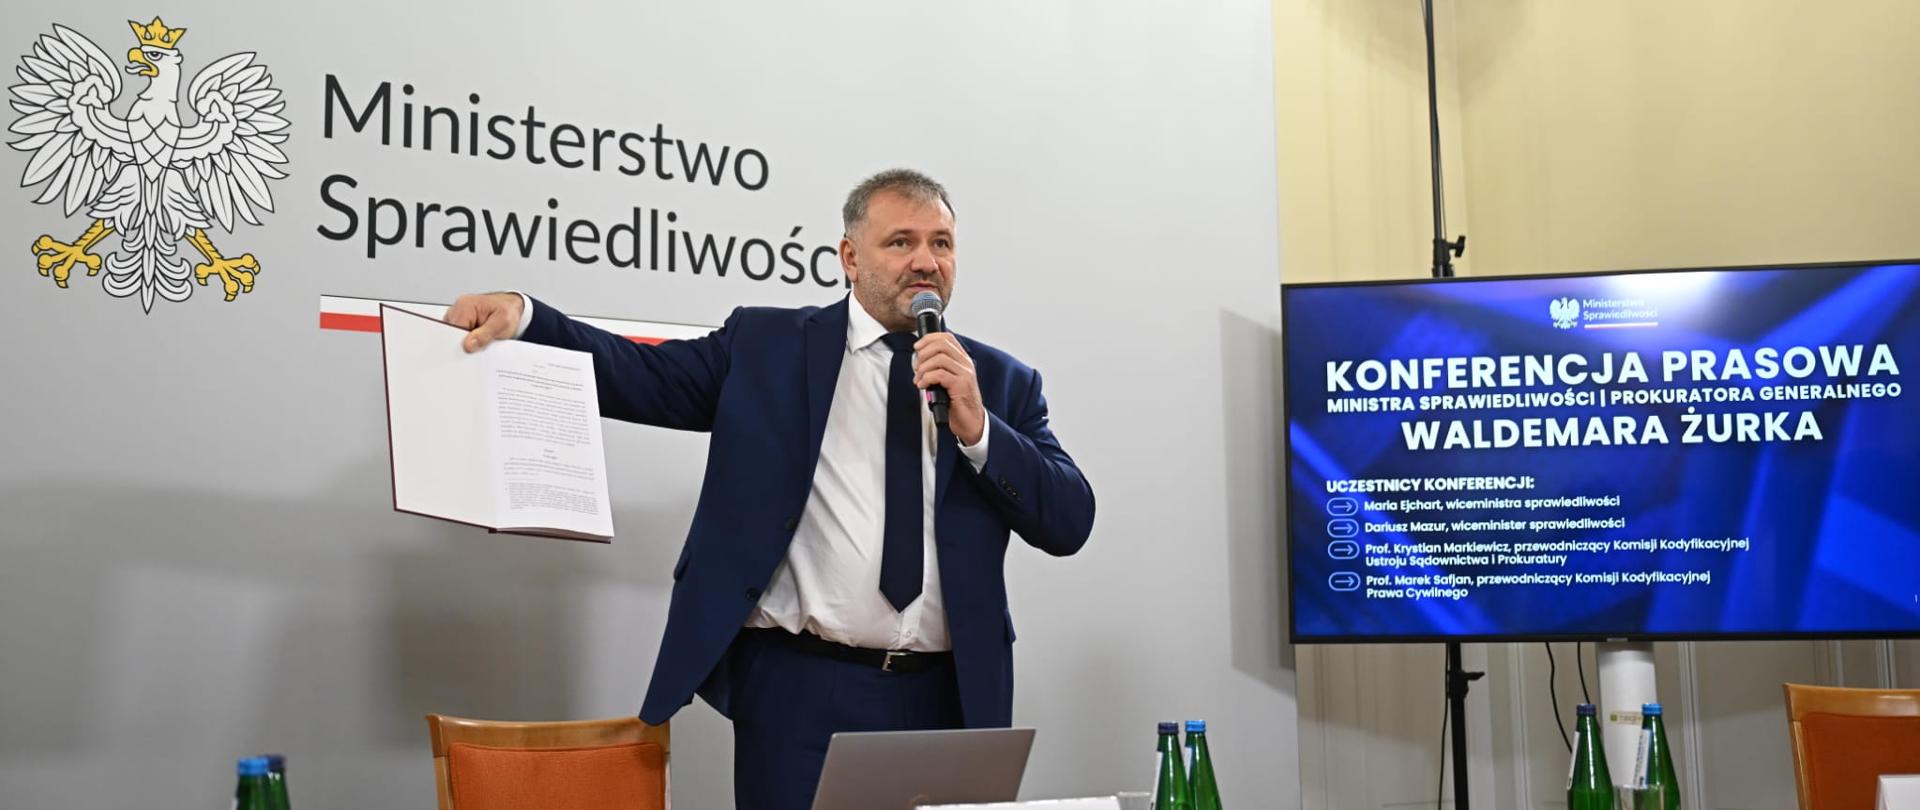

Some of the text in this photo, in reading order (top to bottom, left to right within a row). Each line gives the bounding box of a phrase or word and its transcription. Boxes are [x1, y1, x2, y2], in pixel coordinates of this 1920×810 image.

[323, 73, 770, 190] Ministerstwo
[1326, 343, 1900, 392] KONFERENCJA PRASOWA
[1327, 397, 1415, 413] MINISTRA
[1419, 387, 1595, 410] SPRAWIEDLIWOŚCI
[1611, 386, 1755, 405] PROKURATORA
[1759, 382, 1902, 401] GENERALNEGO
[1401, 406, 1823, 450] WALDEMARA ŻURKA
[1326, 476, 1535, 492] UCZESTNICY KONFERENCJI:
[1364, 495, 1621, 513] Maria Ejchart, wiceministra sprawiedliwości
[1365, 517, 1626, 533] Dariusz Mazur, wiceminister sprawiedliwości
[1365, 537, 1750, 557] Prof. Krystian Markiewicz, przewodniczący Komisji Kodyfikacyjnej
[1365, 553, 1567, 569] Ustroju Sądownictwa i Prokuratury
[1366, 570, 1711, 588] Prof. Marek Safjan, przewodniczący Komisji Kodyfikacyjnej
[1366, 587, 1469, 601] Prawa Cywilnego
